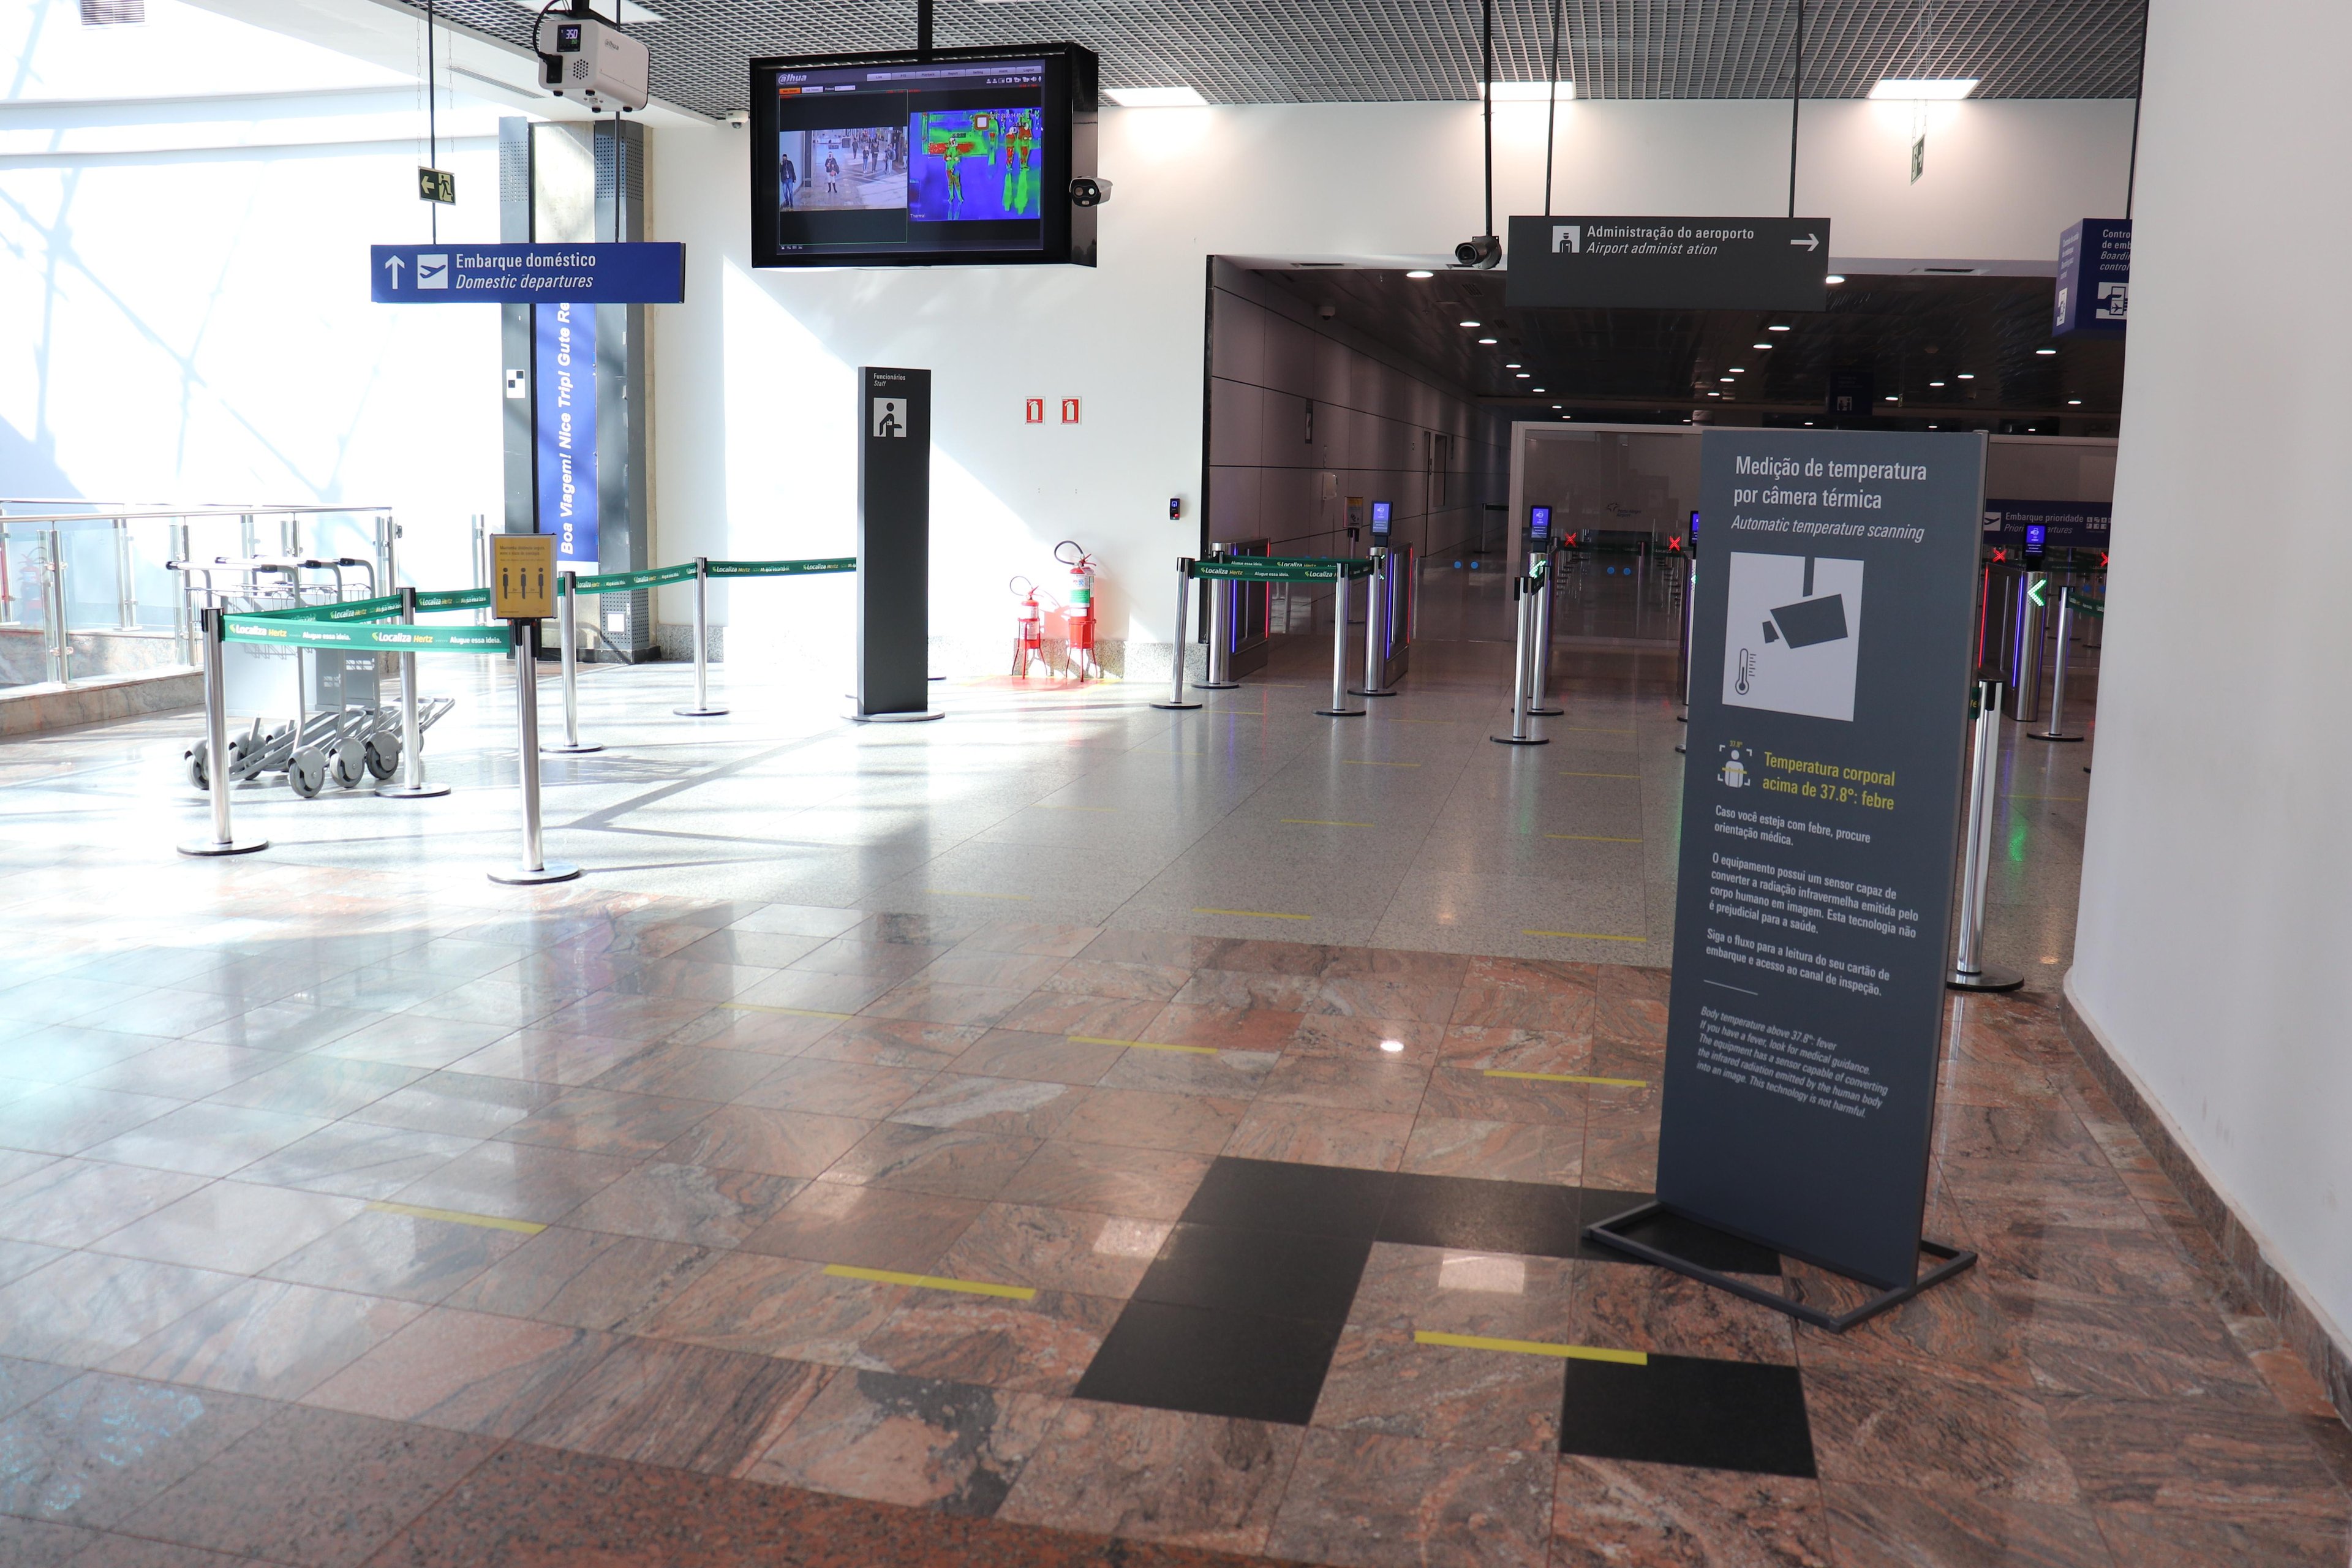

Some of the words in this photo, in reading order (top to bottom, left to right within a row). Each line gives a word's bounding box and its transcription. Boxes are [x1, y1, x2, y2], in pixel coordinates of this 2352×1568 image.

[1586, 242, 1629, 255] Airport
[1587, 225, 1674, 241] Administração
[1678, 226, 1692, 238] do
[1695, 228, 1754, 241] aeroporto
[2102, 240, 2112, 249] de
[2103, 229, 2131, 238] Contro
[456, 253, 522, 271] Embarque
[526, 252, 596, 268] doméstico
[456, 274, 517, 289] Domestic
[520, 274, 594, 291] departures
[557, 328, 570, 366] Gute
[558, 370, 573, 409] Trip!
[559, 412, 572, 448] Nice
[559, 452, 575, 518] Viagem!
[1736, 456, 1799, 480] Medição
[1804, 458, 1823, 477] de
[1828, 461, 1926, 483] temperatura
[1734, 489, 1758, 506] por
[1762, 486, 1817, 505] câmera
[1822, 488, 1881, 508] térmica
[1730, 514, 1789, 532] Automatic
[1792, 519, 1864, 537] temperature
[1867, 524, 1924, 543] scanning
[2005, 512, 2043, 522] Embarque
[2046, 514, 2083, 522] prioridade
[560, 522, 573, 555] Boa
[379, 631, 412, 643] Localiza
[413, 635, 433, 643] Hertz
[450, 636, 470, 645] Alugue
[1765, 752, 1839, 777] Temperatura
[1843, 767, 1894, 786] corporal
[1762, 777, 1798, 794] acima
[1801, 781, 1816, 797] de
[1861, 790, 1894, 810] febre
[1714, 823, 1758, 839] orientação
[1760, 831, 1793, 845] médica.
[1715, 804, 1735, 818] Caso
[1738, 811, 1757, 822] você
[1759, 815, 1784, 829] esteja
[1787, 820, 1805, 831] com
[1808, 821, 1833, 837] febre,
[1836, 829, 1870, 843] procure
[1713, 852, 1719, 863] O
[1721, 856, 1775, 875] equipamento
[1777, 868, 1805, 881] possui
[1807, 874, 1822, 884] um
[1823, 877, 1854, 891] sensor
[1856, 884, 1882, 897] capaz
[1885, 887, 1896, 899] de
[1710, 886, 1733, 899] corpo
[1735, 889, 1769, 906] humano
[1771, 899, 1784, 910] em
[1787, 900, 1823, 918] imagem.
[1826, 908, 1845, 923] Esta
[1849, 914, 1896, 934] tecnologia
[1898, 925, 1916, 938] não
[1711, 870, 1751, 885] converter
[1759, 880, 1796, 895] radiação
[1798, 886, 1858, 908] infravermelha
[1861, 902, 1896, 916] emitida
[1898, 908, 1918, 921] pelo
[1716, 903, 1759, 920] prejudicial
[1761, 913, 1779, 925] para
[1782, 918, 1787, 927] a
[1790, 919, 1818, 933] saúde.
[1706, 928, 1725, 943] Siga
[1735, 934, 1754, 949] fluxo
[1757, 942, 1776, 955] para
[1777, 947, 1783, 956] a
[1785, 946, 1812, 962] leitura
[1815, 954, 1826, 966] do
[1828, 959, 1844, 970] seu
[1847, 963, 1875, 977] cartão
[1878, 968, 1890, 981] de
[1706, 946, 1746, 963] embarque
[1748, 956, 1754, 965] e
[1755, 958, 1784, 972] acesso
[1787, 965, 1797, 975] ao
[1800, 968, 1823, 981] canal
[1825, 973, 1836, 985] de
[1839, 975, 1882, 996] inspeção.
[1700, 1006, 1719, 1020] Body
[1720, 1012, 1765, 1031] temperature
[1766, 1025, 1790, 1038] above
[1816, 1036, 1837, 1050] fever
[1699, 1033, 1712, 1045] The
[1713, 1039, 1752, 1057] equipment
[1753, 1049, 1767, 1060] has
[1774, 1057, 1801, 1069] sensor
[1802, 1064, 1833, 1079] capable
[1834, 1072, 1844, 1082] of
[1844, 1076, 1888, 1095] converting
[1700, 1020, 1706, 1028] If
[1706, 1023, 1721, 1033] you
[1721, 1025, 1739, 1038] have
[1746, 1033, 1767, 1047] fever,
[1769, 1039, 1785, 1052] look
[1787, 1043, 1798, 1055] for
[1799, 1049, 1831, 1064] medical
[1831, 1058, 1869, 1075] guidance.
[1696, 1060, 1711, 1072] into
[1711, 1066, 1722, 1075] an
[1722, 1068, 1746, 1083] image.
[1749, 1075, 1765, 1088] This
[1766, 1082, 1808, 1102] technology
[1809, 1093, 1817, 1103] is
[1817, 1097, 1831, 1107] not
[1832, 1099, 1865, 1117] harmful.
[1697, 1047, 1709, 1058] the
[1711, 1050, 1740, 1066] infrared
[1740, 1061, 1774, 1076] radiation
[1774, 1071, 1806, 1085] emitted
[1806, 1077, 1816, 1090] by
[1817, 1082, 1831, 1093] the
[1832, 1085, 1860, 1101] human
[1861, 1093, 1883, 1107] body
